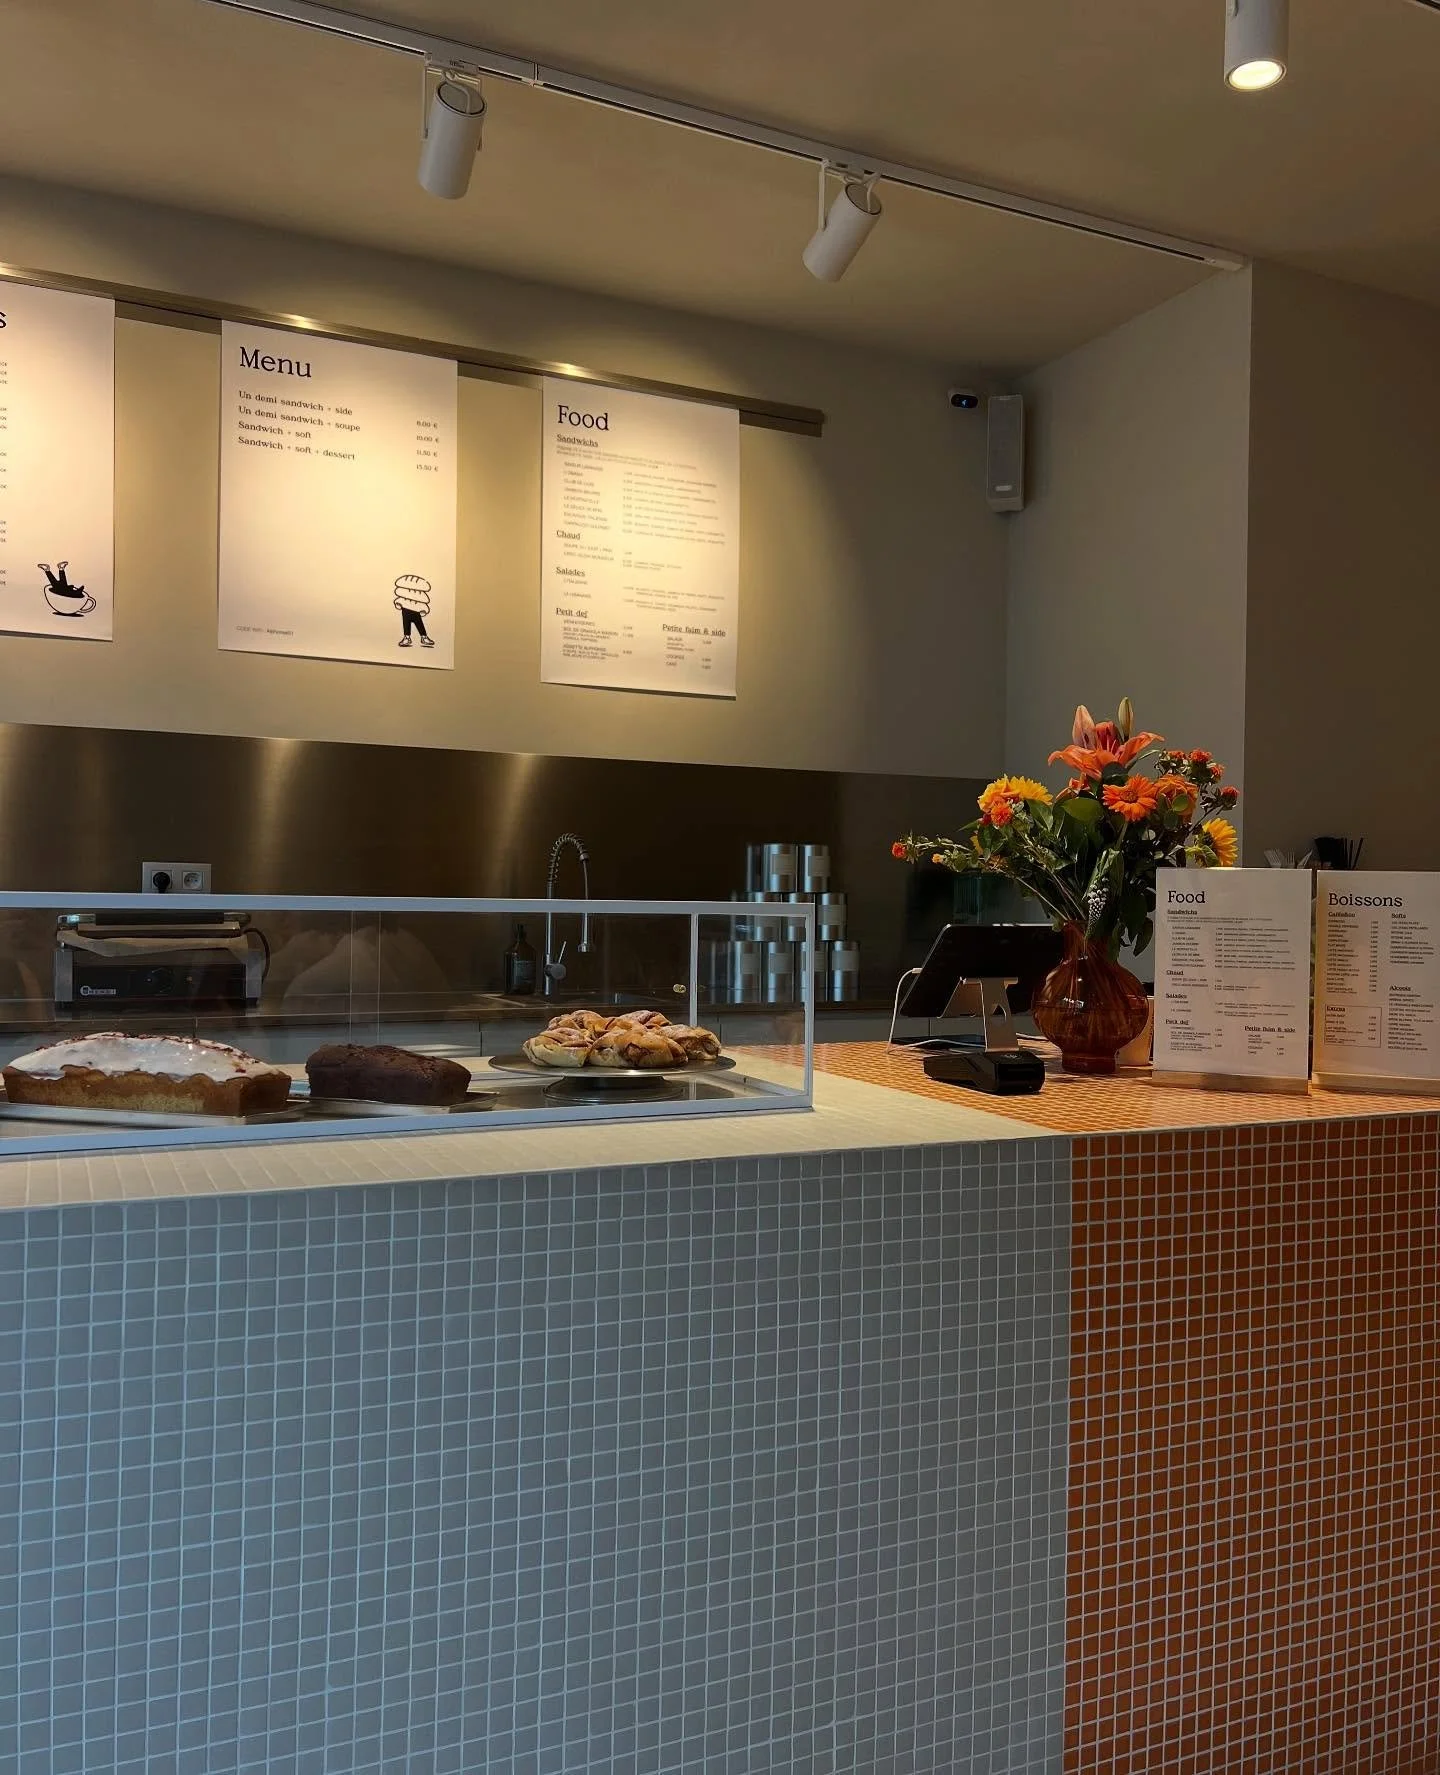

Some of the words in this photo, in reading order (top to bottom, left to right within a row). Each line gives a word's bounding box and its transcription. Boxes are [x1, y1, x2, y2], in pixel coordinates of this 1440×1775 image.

[239, 346, 312, 378] Menu
[239, 390, 252, 400] Un
[255, 394, 277, 404] demi
[281, 398, 324, 411] sandwich
[335, 405, 353, 416] side
[239, 405, 252, 415] Un
[255, 409, 277, 419] demi
[281, 414, 324, 426] sandwich
[335, 420, 360, 432] soupe
[557, 404, 610, 431] Food
[238, 420, 284, 435] Sandwich
[295, 429, 312, 439] soft
[238, 435, 284, 450] Sandwich
[295, 445, 312, 454] soft
[323, 448, 355, 461] dessert
[556, 433, 599, 448] Sandwichs
[556, 529, 581, 541] Chaud
[555, 566, 586, 577] Salades
[555, 607, 573, 618] Petit
[662, 623, 683, 634] Petite
[685, 627, 701, 635] faim
[712, 629, 727, 638] side
[1167, 890, 1206, 904] Food
[1328, 892, 1404, 908] Boissons
